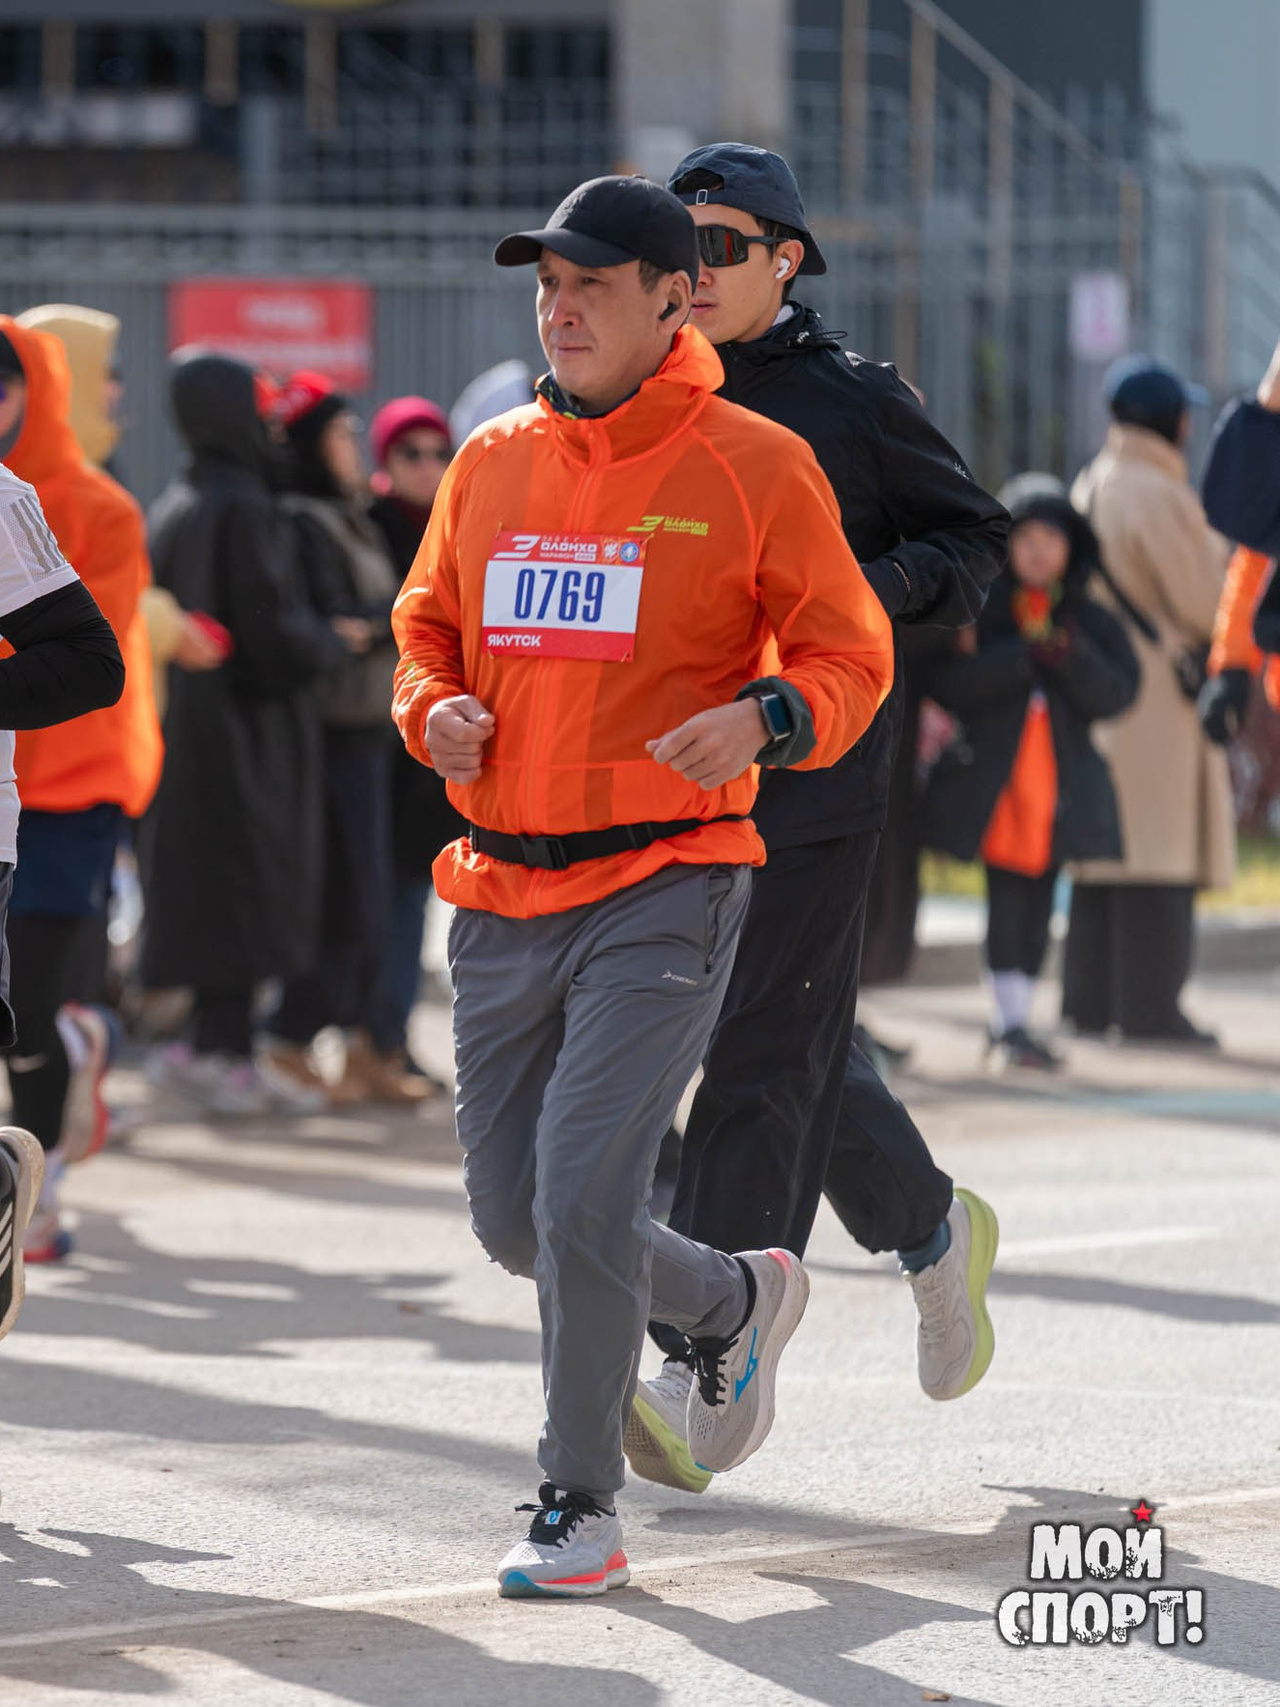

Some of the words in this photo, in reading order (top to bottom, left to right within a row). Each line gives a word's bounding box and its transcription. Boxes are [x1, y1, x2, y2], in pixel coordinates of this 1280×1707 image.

[540, 541, 597, 553] ОЛОНХО
[514, 568, 606, 623] 0769
[487, 634, 542, 647] ЯКУТСК
